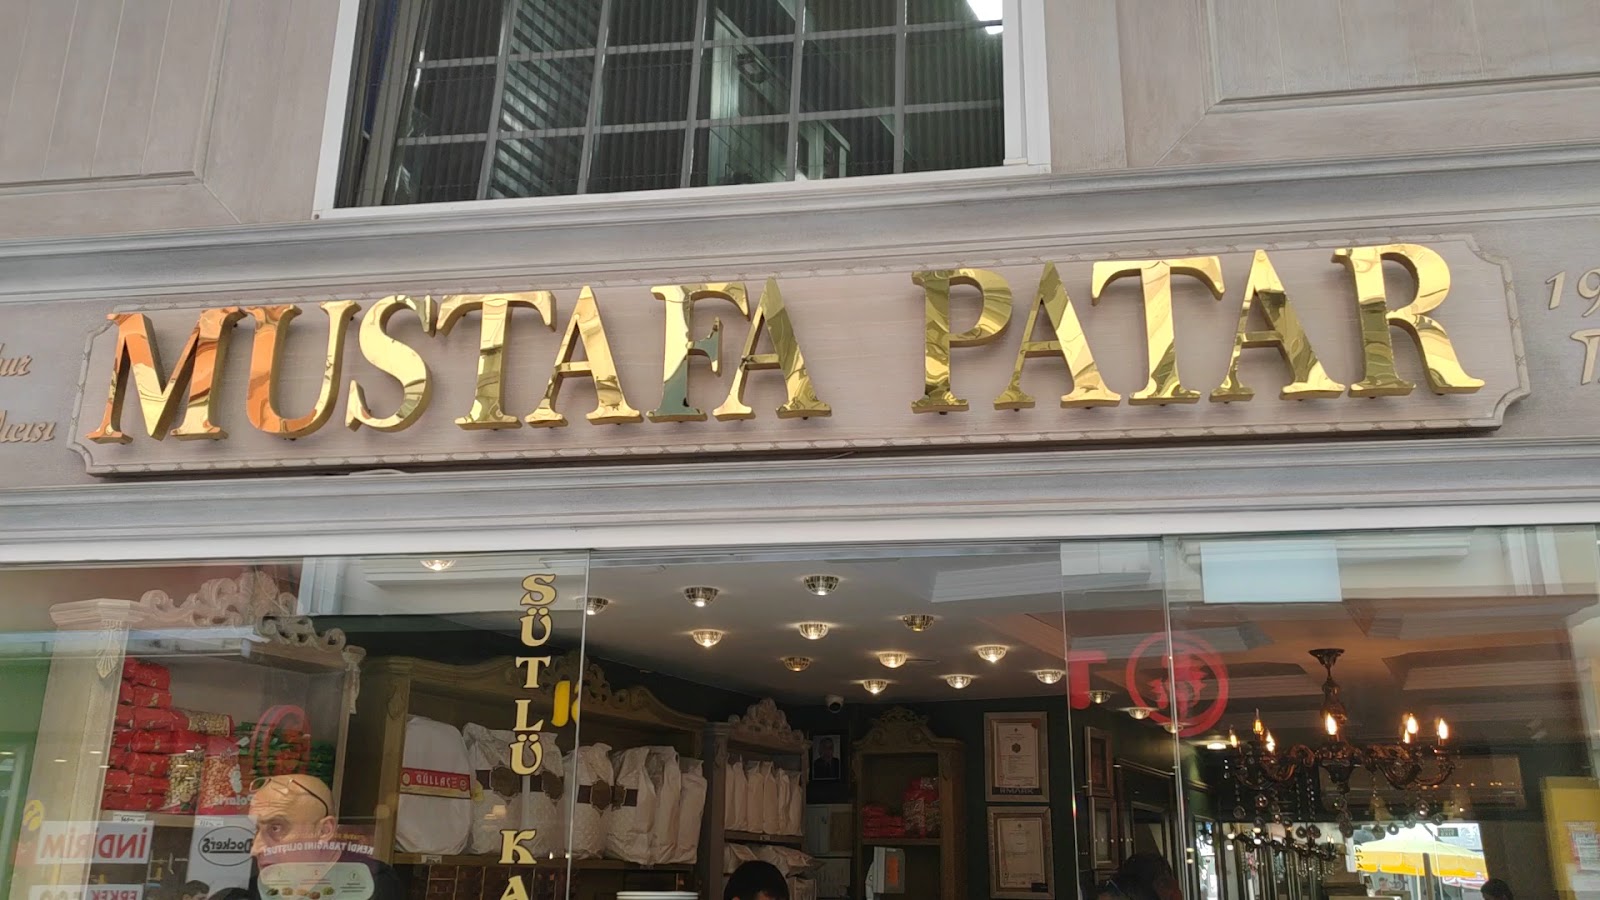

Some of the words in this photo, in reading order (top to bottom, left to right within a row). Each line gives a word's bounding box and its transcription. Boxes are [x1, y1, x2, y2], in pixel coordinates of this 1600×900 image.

[85, 277, 832, 444] MUSTAFA
[911, 243, 1485, 413] PATAR
[510, 573, 557, 775] SÜTLÜ
